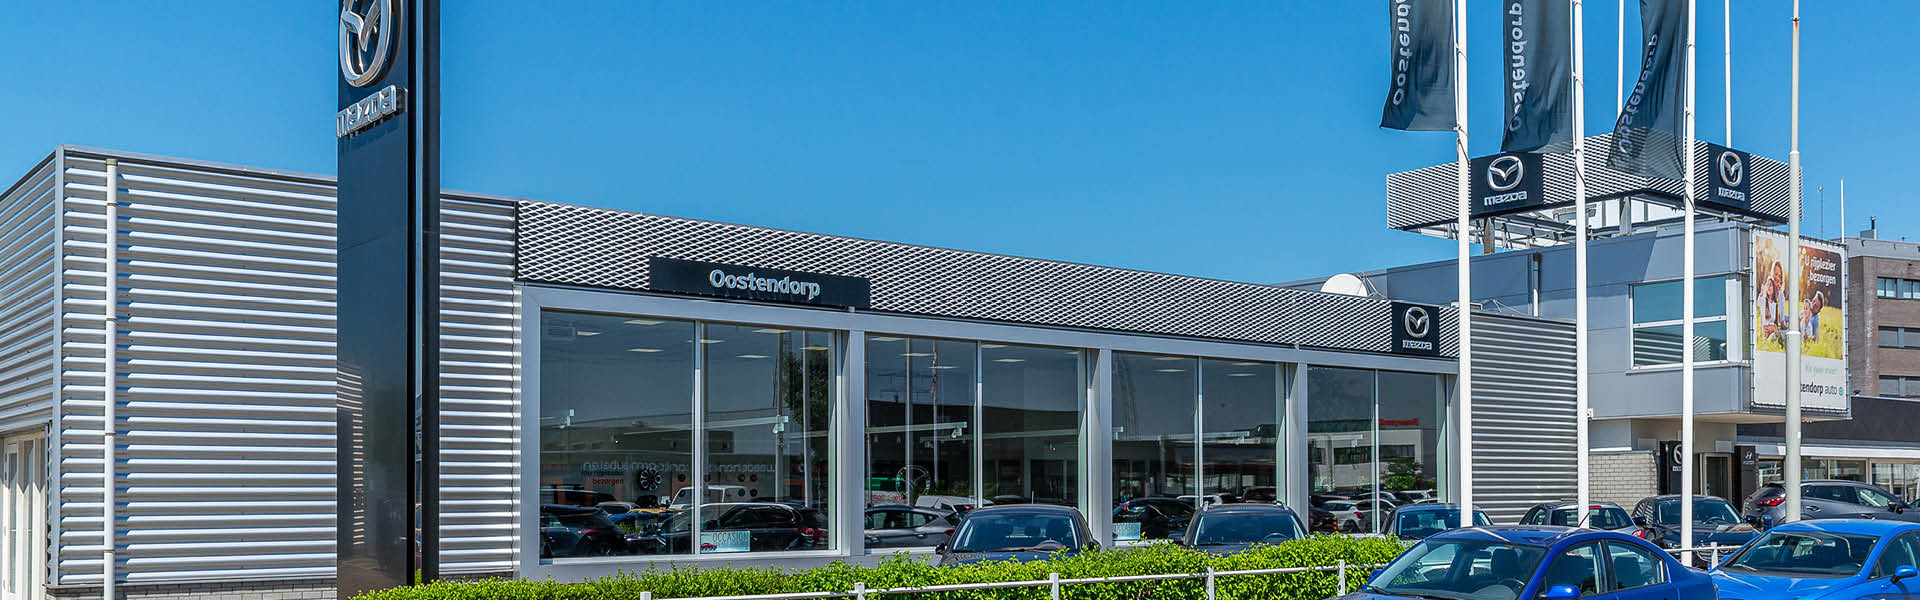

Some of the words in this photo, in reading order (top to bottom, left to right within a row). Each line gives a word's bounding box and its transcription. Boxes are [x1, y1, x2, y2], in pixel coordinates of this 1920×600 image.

[1810, 256, 1836, 271] rijplezier
[709, 269, 821, 300] Oostendorp
[1809, 270, 1836, 286] bezorgen
[1824, 385, 1838, 395] auto
